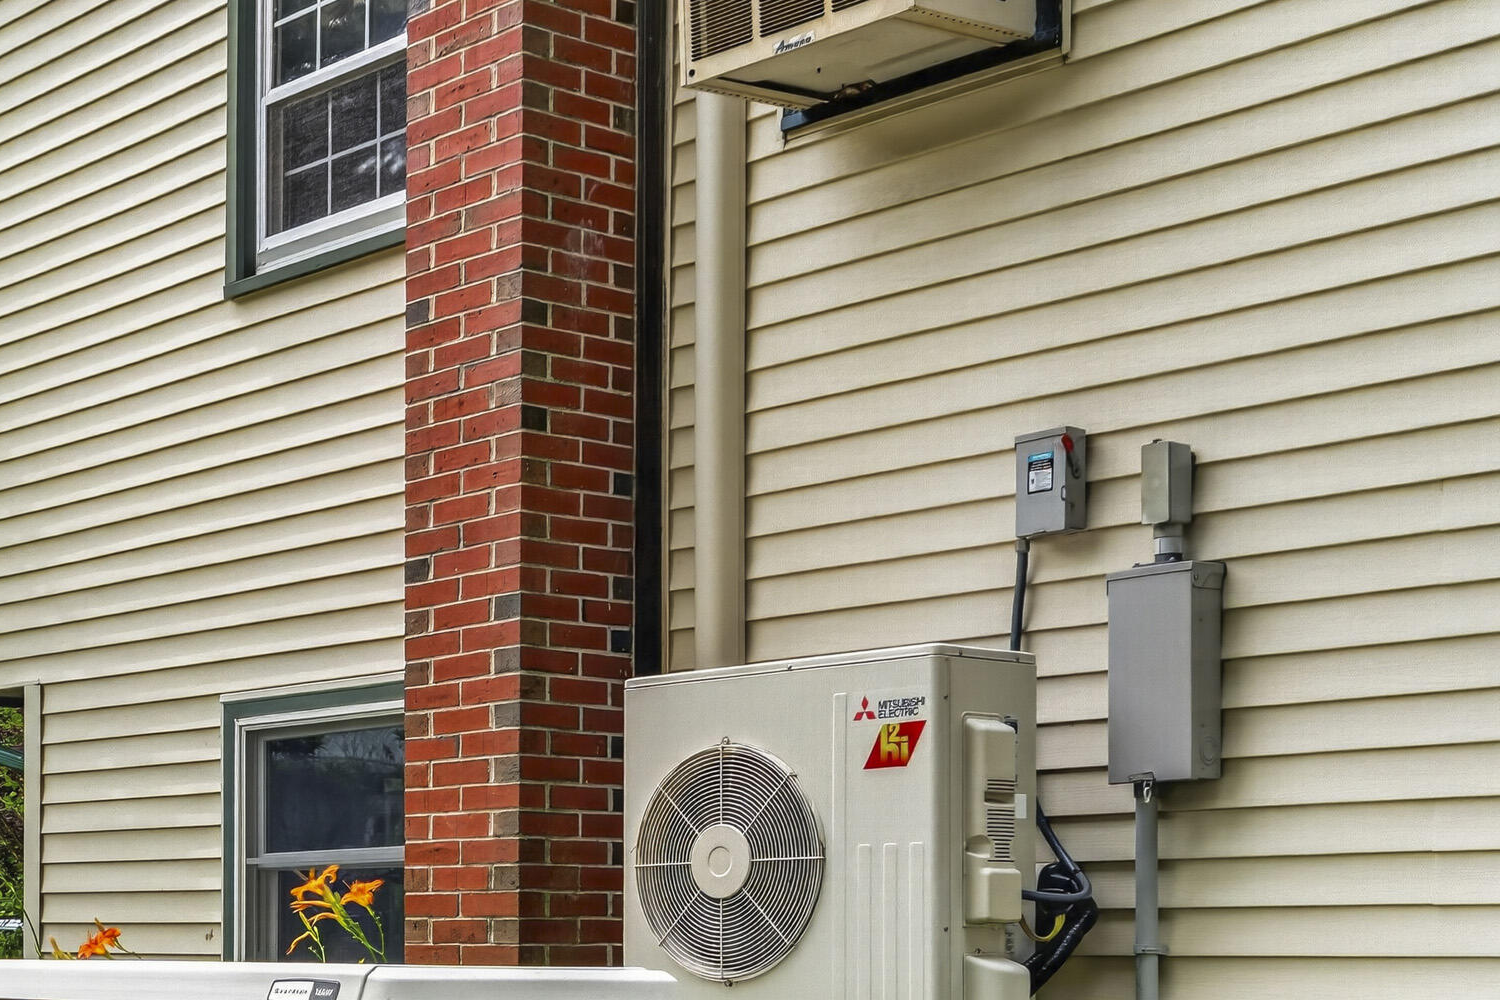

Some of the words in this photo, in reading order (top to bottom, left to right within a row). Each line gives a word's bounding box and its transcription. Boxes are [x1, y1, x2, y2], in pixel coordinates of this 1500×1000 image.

[774, 36, 813, 55] Amana
[878, 696, 926, 711] MITSUBISHI
[878, 707, 919, 719] ELECTRIC
